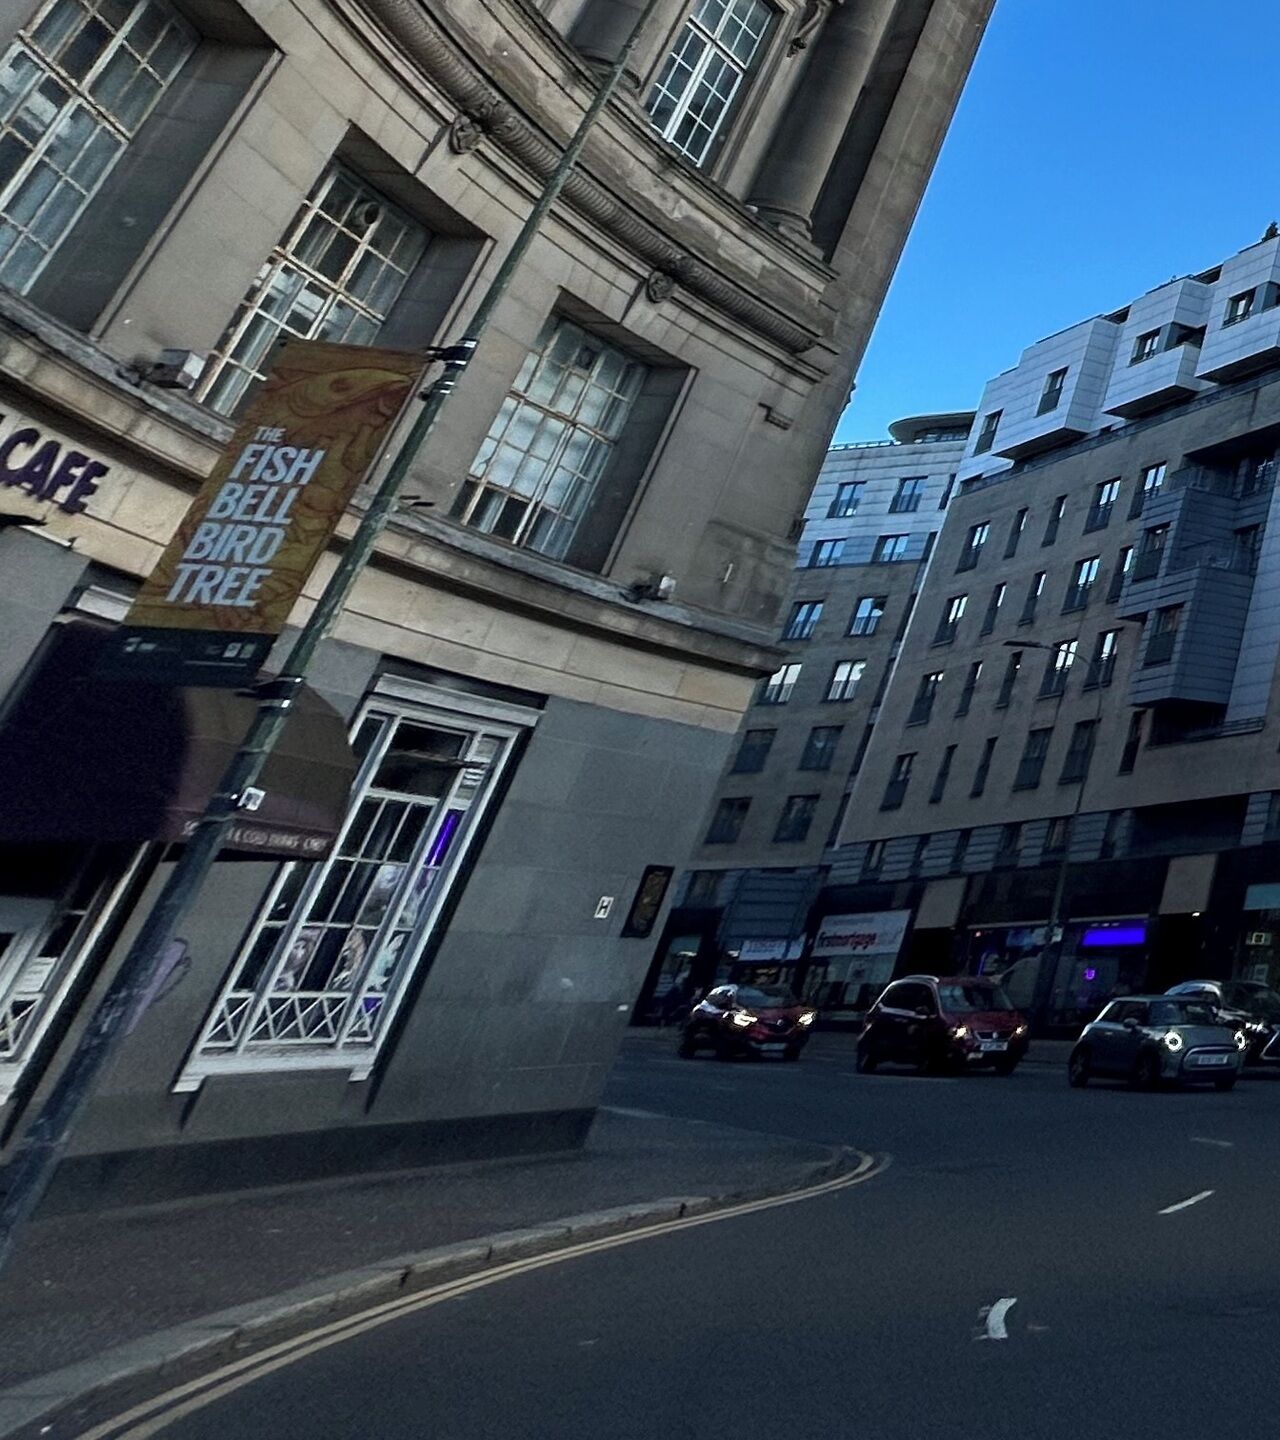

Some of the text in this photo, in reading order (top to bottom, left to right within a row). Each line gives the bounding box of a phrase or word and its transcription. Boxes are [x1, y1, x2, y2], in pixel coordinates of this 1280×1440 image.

[254, 426, 287, 442] THE
[0, 427, 110, 515] CAFE
[228, 443, 327, 486] FISH
[206, 482, 300, 525] BELL
[183, 522, 286, 566] BIRD
[165, 563, 273, 607] TREE
